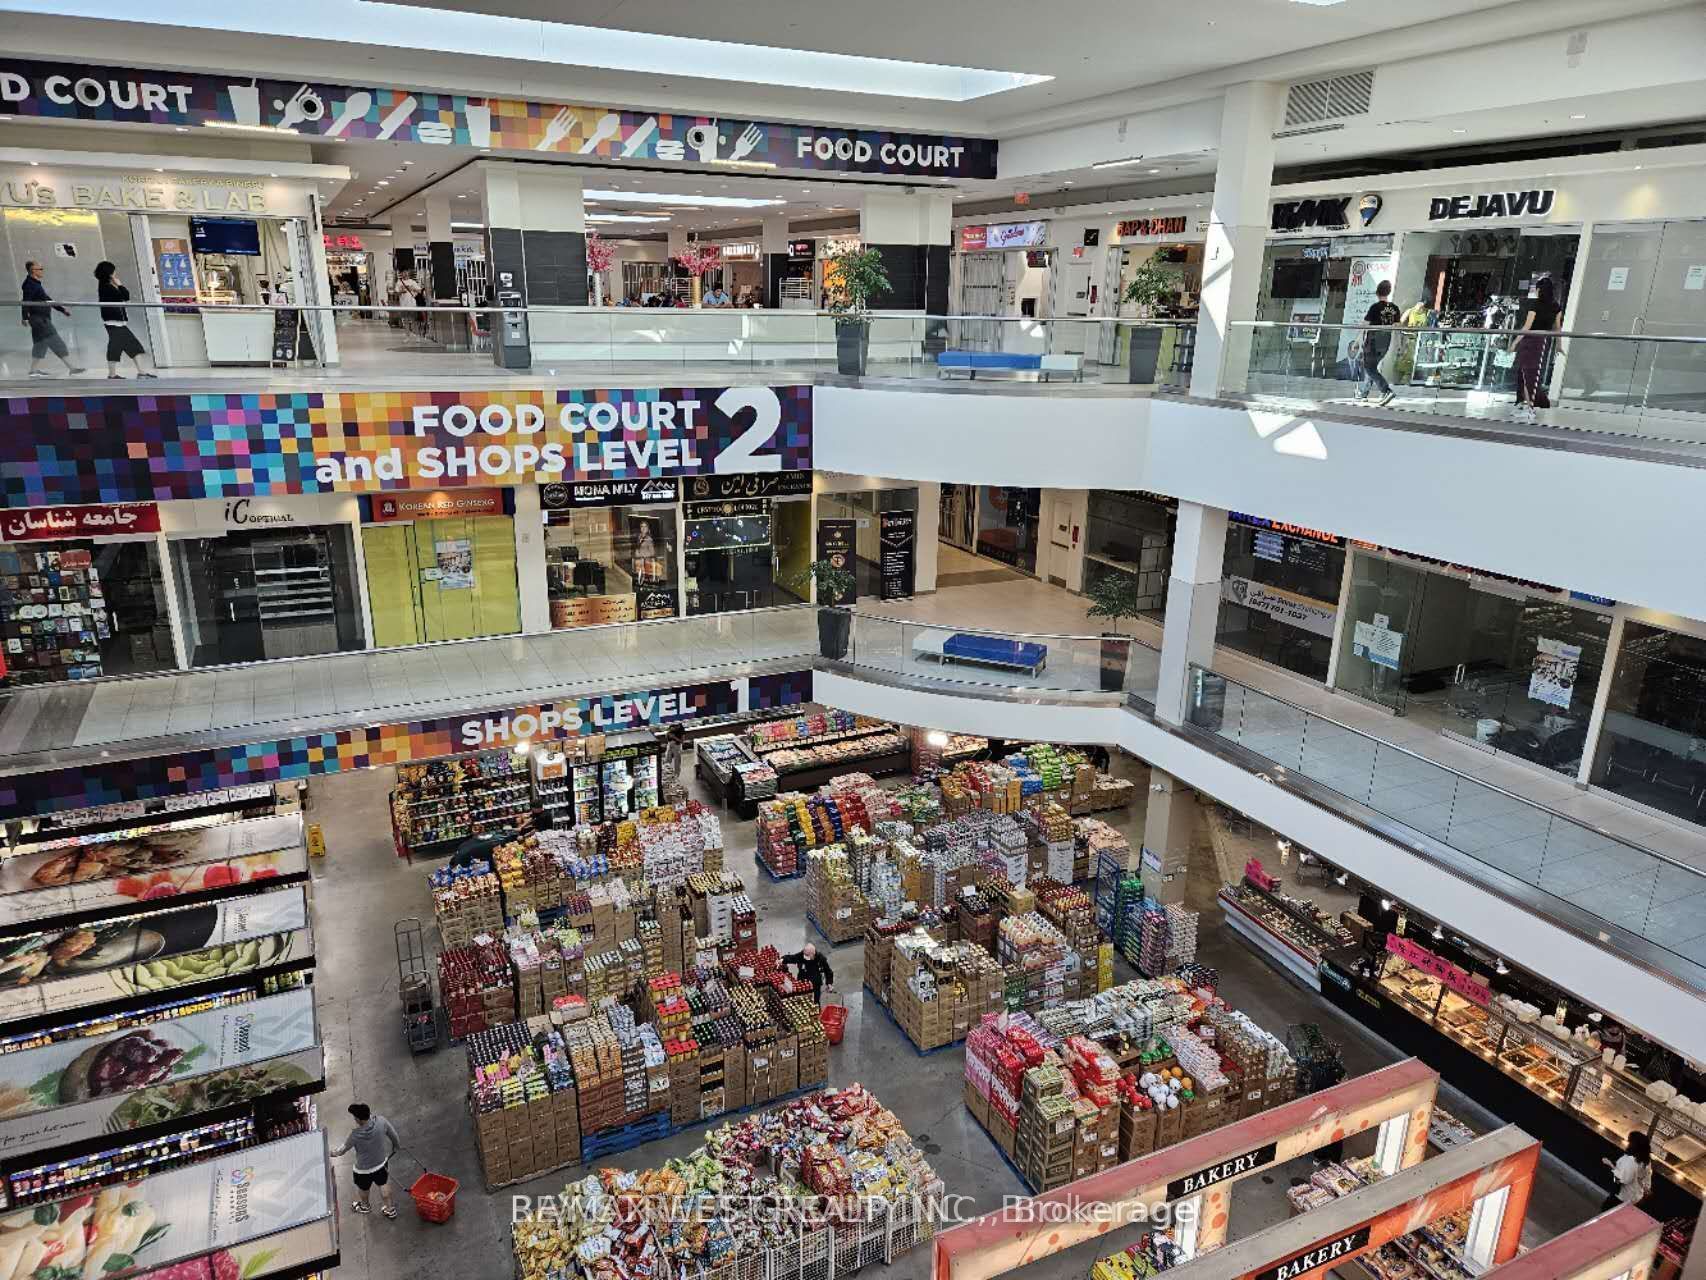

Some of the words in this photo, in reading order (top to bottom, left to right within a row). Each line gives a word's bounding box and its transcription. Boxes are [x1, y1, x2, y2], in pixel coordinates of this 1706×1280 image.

[45, 75, 193, 114] COURT
[797, 136, 871, 163] FOOD
[880, 142, 965, 168] COURT
[72, 184, 165, 209] BAKE
[174, 190, 194, 209] &
[202, 191, 266, 211] LAB
[1429, 189, 1557, 221] DEJAVU
[413, 403, 545, 438] FOOD
[560, 400, 702, 434] COURT
[713, 385, 783, 473] 2
[316, 447, 404, 484] and
[417, 443, 566, 480] SHOPS
[579, 438, 702, 472] LEVEL
[8, 509, 78, 536] شناسان
[83, 507, 139, 531] جامعه
[398, 502, 435, 511] KOREAN
[462, 707, 583, 747] SHOPS
[594, 692, 697, 727] LEVEL
[730, 678, 750, 714] 1
[1183, 1153, 1259, 1194] BAKERY
[1276, 1234, 1357, 1280] BAKERY
